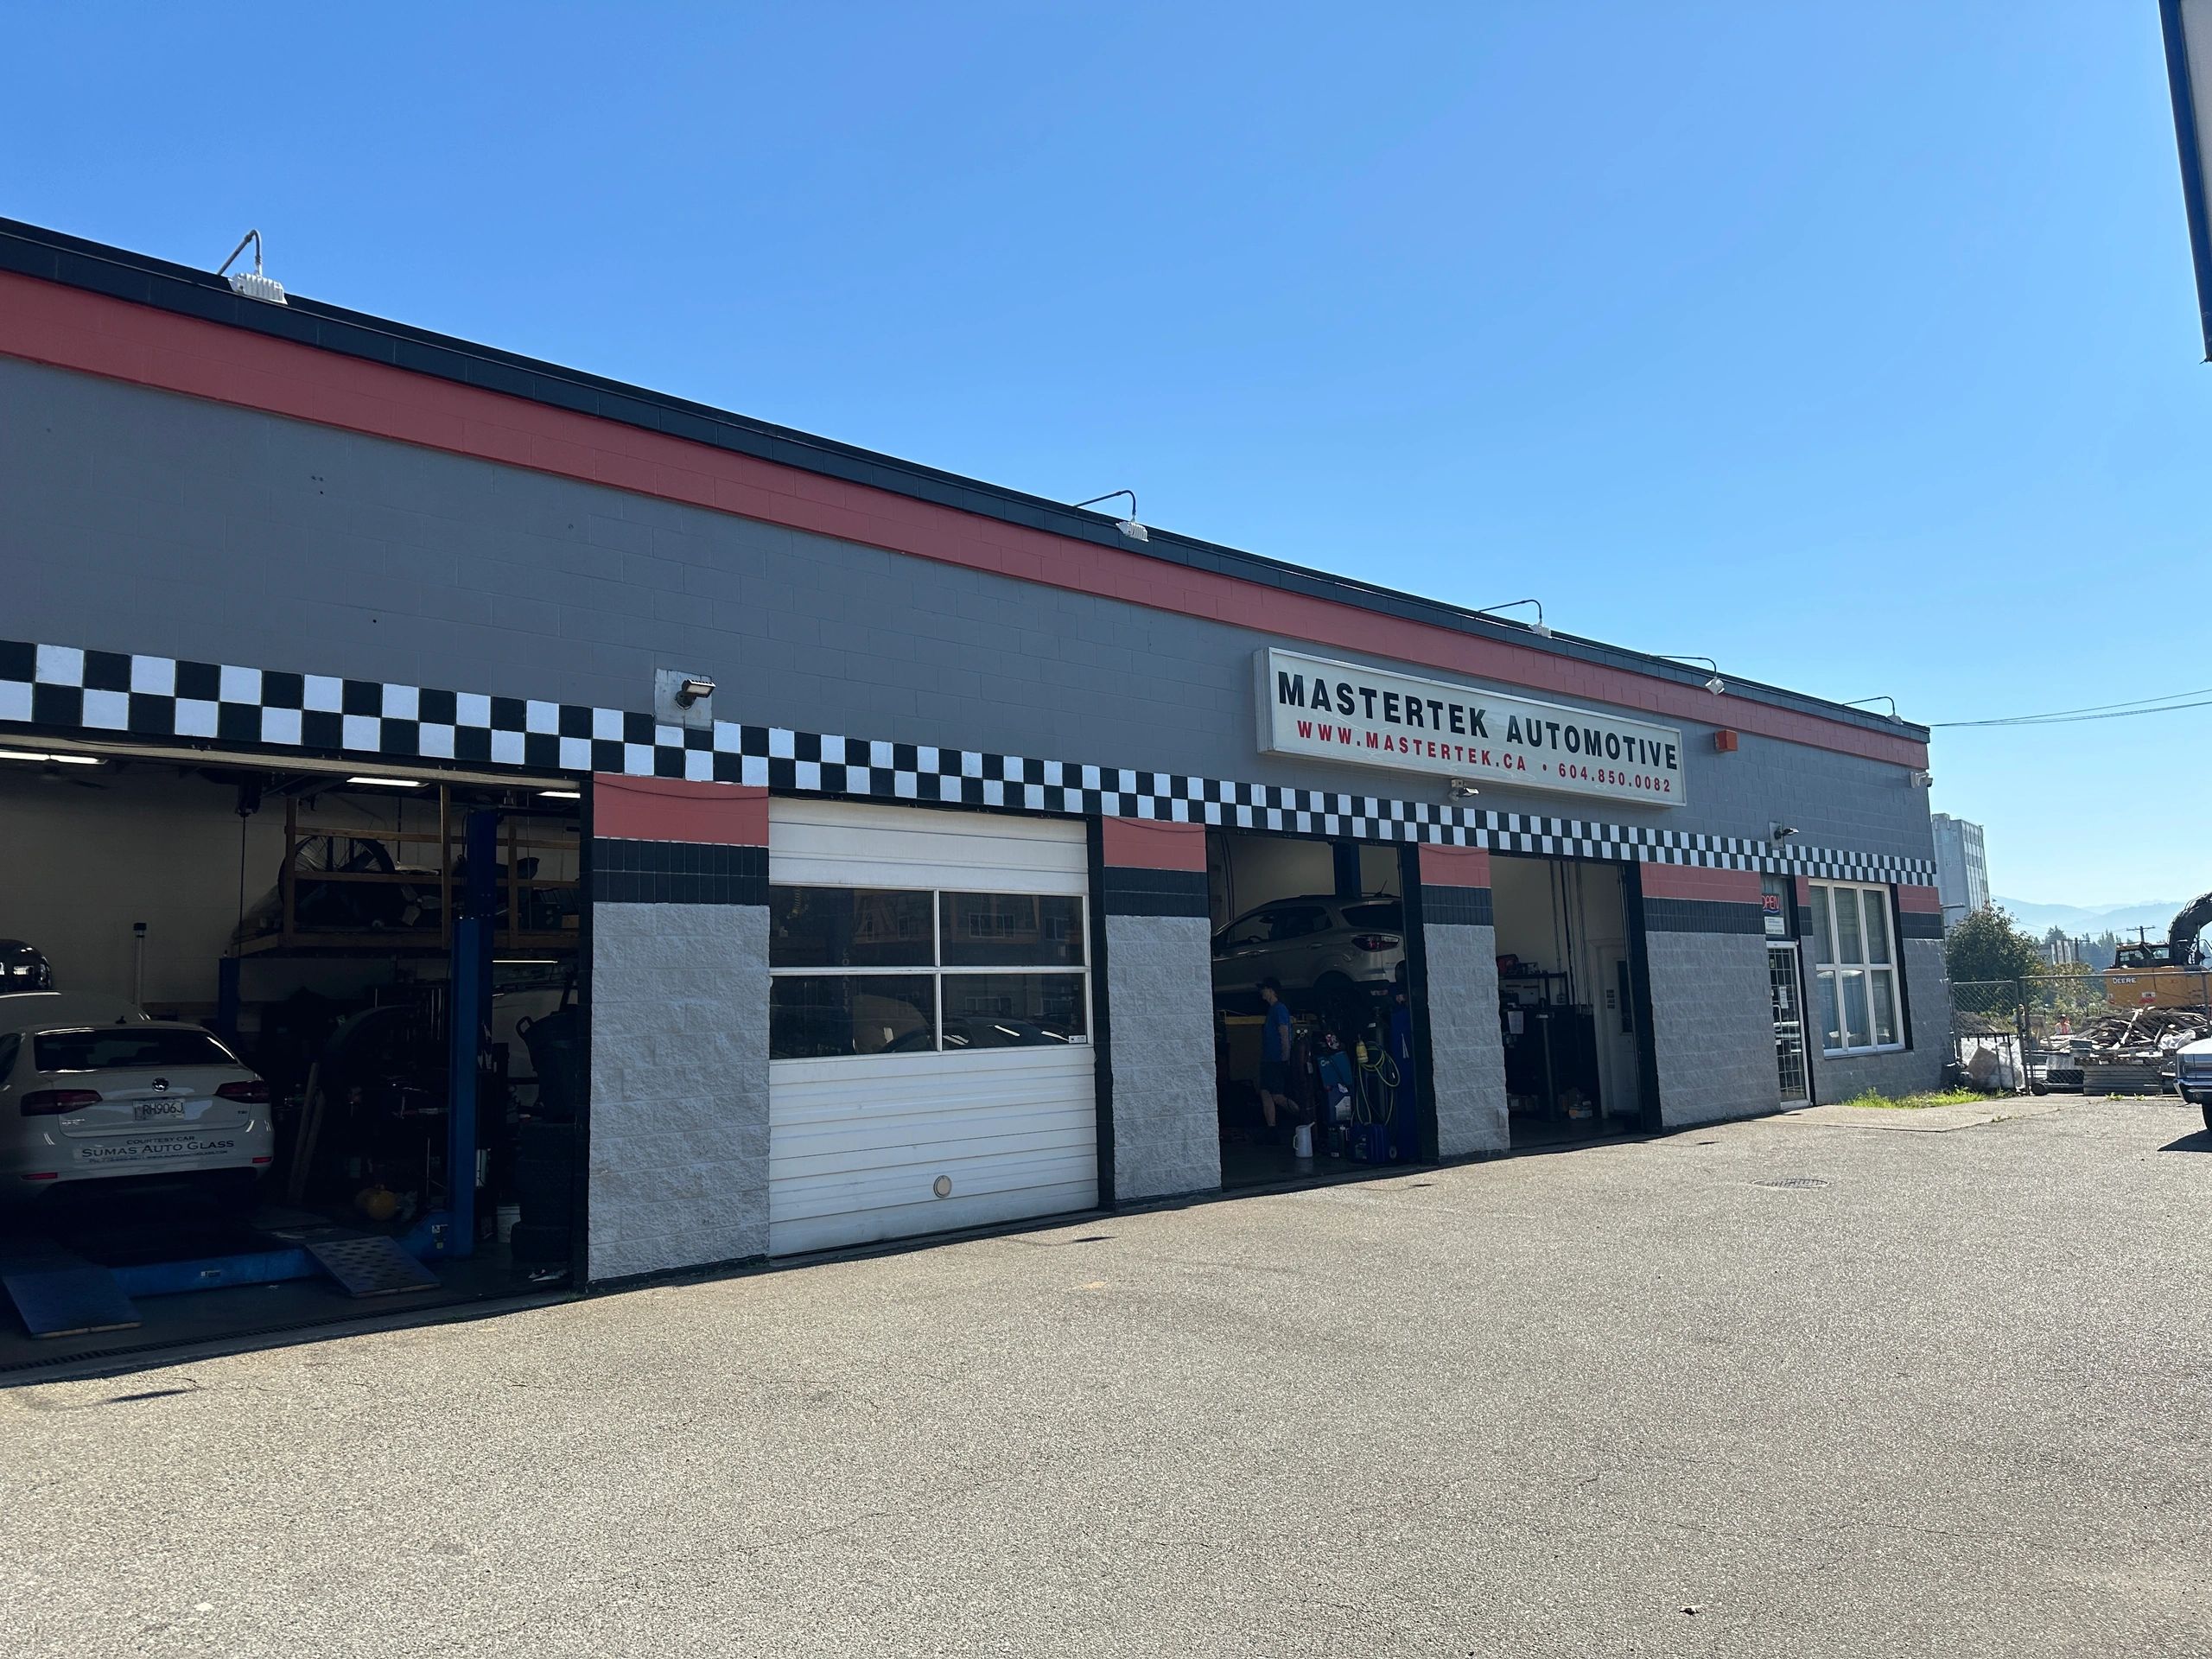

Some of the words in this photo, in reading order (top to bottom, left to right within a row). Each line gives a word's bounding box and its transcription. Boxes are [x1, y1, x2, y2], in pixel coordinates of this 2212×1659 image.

[1277, 671, 1489, 740] MASTERTEK
[1506, 714, 1678, 771] AUTOMOTIVE
[1297, 720, 1527, 772] WWW.MASTERTEK.CA
[1558, 763, 1671, 792] 604.850.0082
[82, 1147, 137, 1158] SUMAS
[142, 1143, 183, 1154] AUTO
[187, 1140, 235, 1150] GLASS
